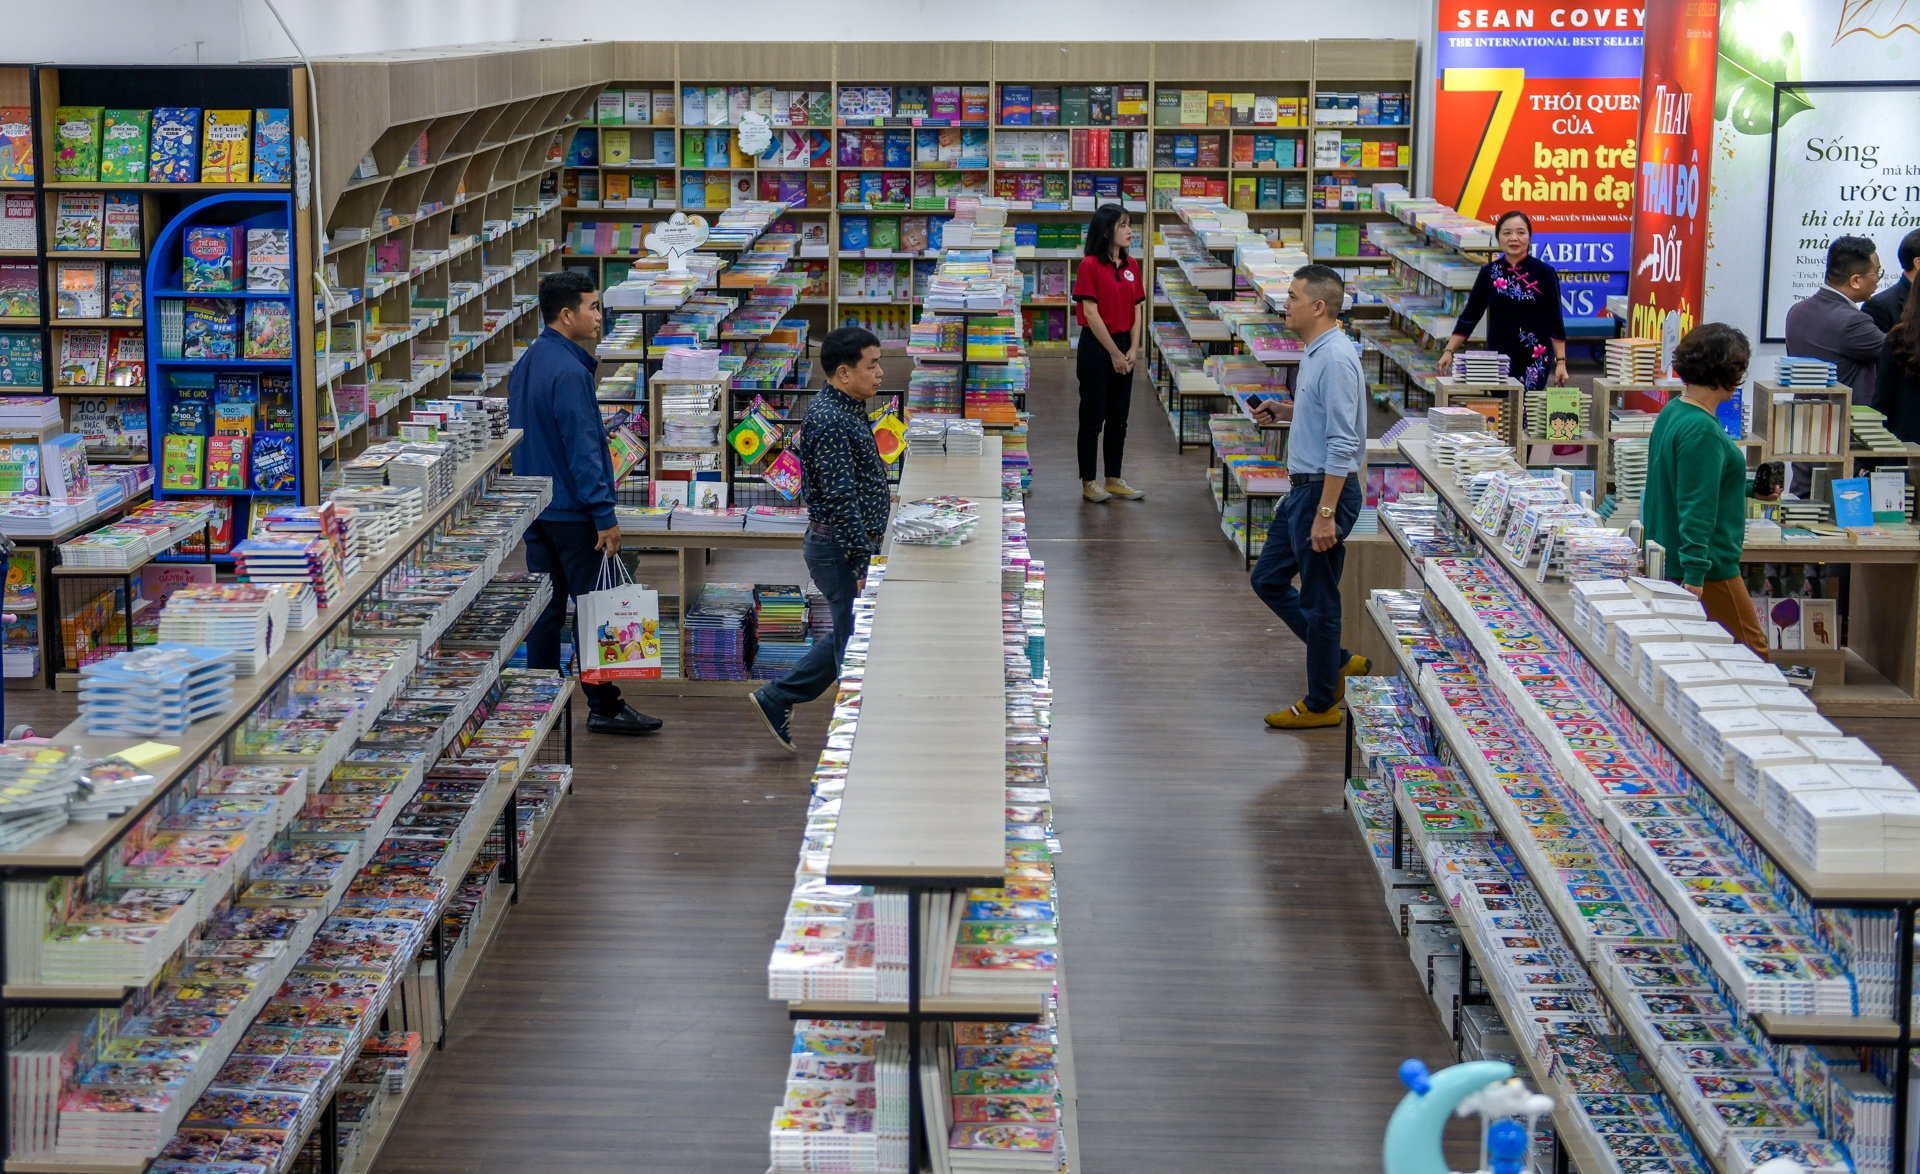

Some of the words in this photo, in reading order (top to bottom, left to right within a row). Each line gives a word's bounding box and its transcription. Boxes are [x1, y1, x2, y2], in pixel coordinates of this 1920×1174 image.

[1457, 9, 1534, 28] SEAN
[1550, 9, 1645, 27] COVEY
[1449, 38, 1473, 47] THE
[1475, 37, 1570, 47] INTERNATIONAL
[1572, 37, 1601, 46] BEST
[1530, 92, 1582, 111] THÓI
[1587, 95, 1641, 113] QUEN
[1653, 85, 1693, 134] THAY
[1552, 115, 1594, 134] CỦA
[1441, 68, 1525, 219] 7
[1806, 136, 1880, 169] Sống
[1534, 142, 1589, 176] bạn
[1595, 139, 1637, 169] trẻ
[1882, 165, 1902, 176] mà
[1500, 174, 1587, 202] thành
[1594, 174, 1635, 209] đạt
[1643, 148, 1674, 216] THÁI
[1676, 149, 1699, 235] ĐỘ
[1839, 179, 1897, 202] ước
[1801, 210, 1828, 227] thì
[1833, 210, 1864, 227] chỉ
[1868, 210, 1885, 227] là
[1649, 225, 1682, 283] ĐỔI
[1044, 267, 1064, 277] Quick
[79, 401, 107, 414] 100
